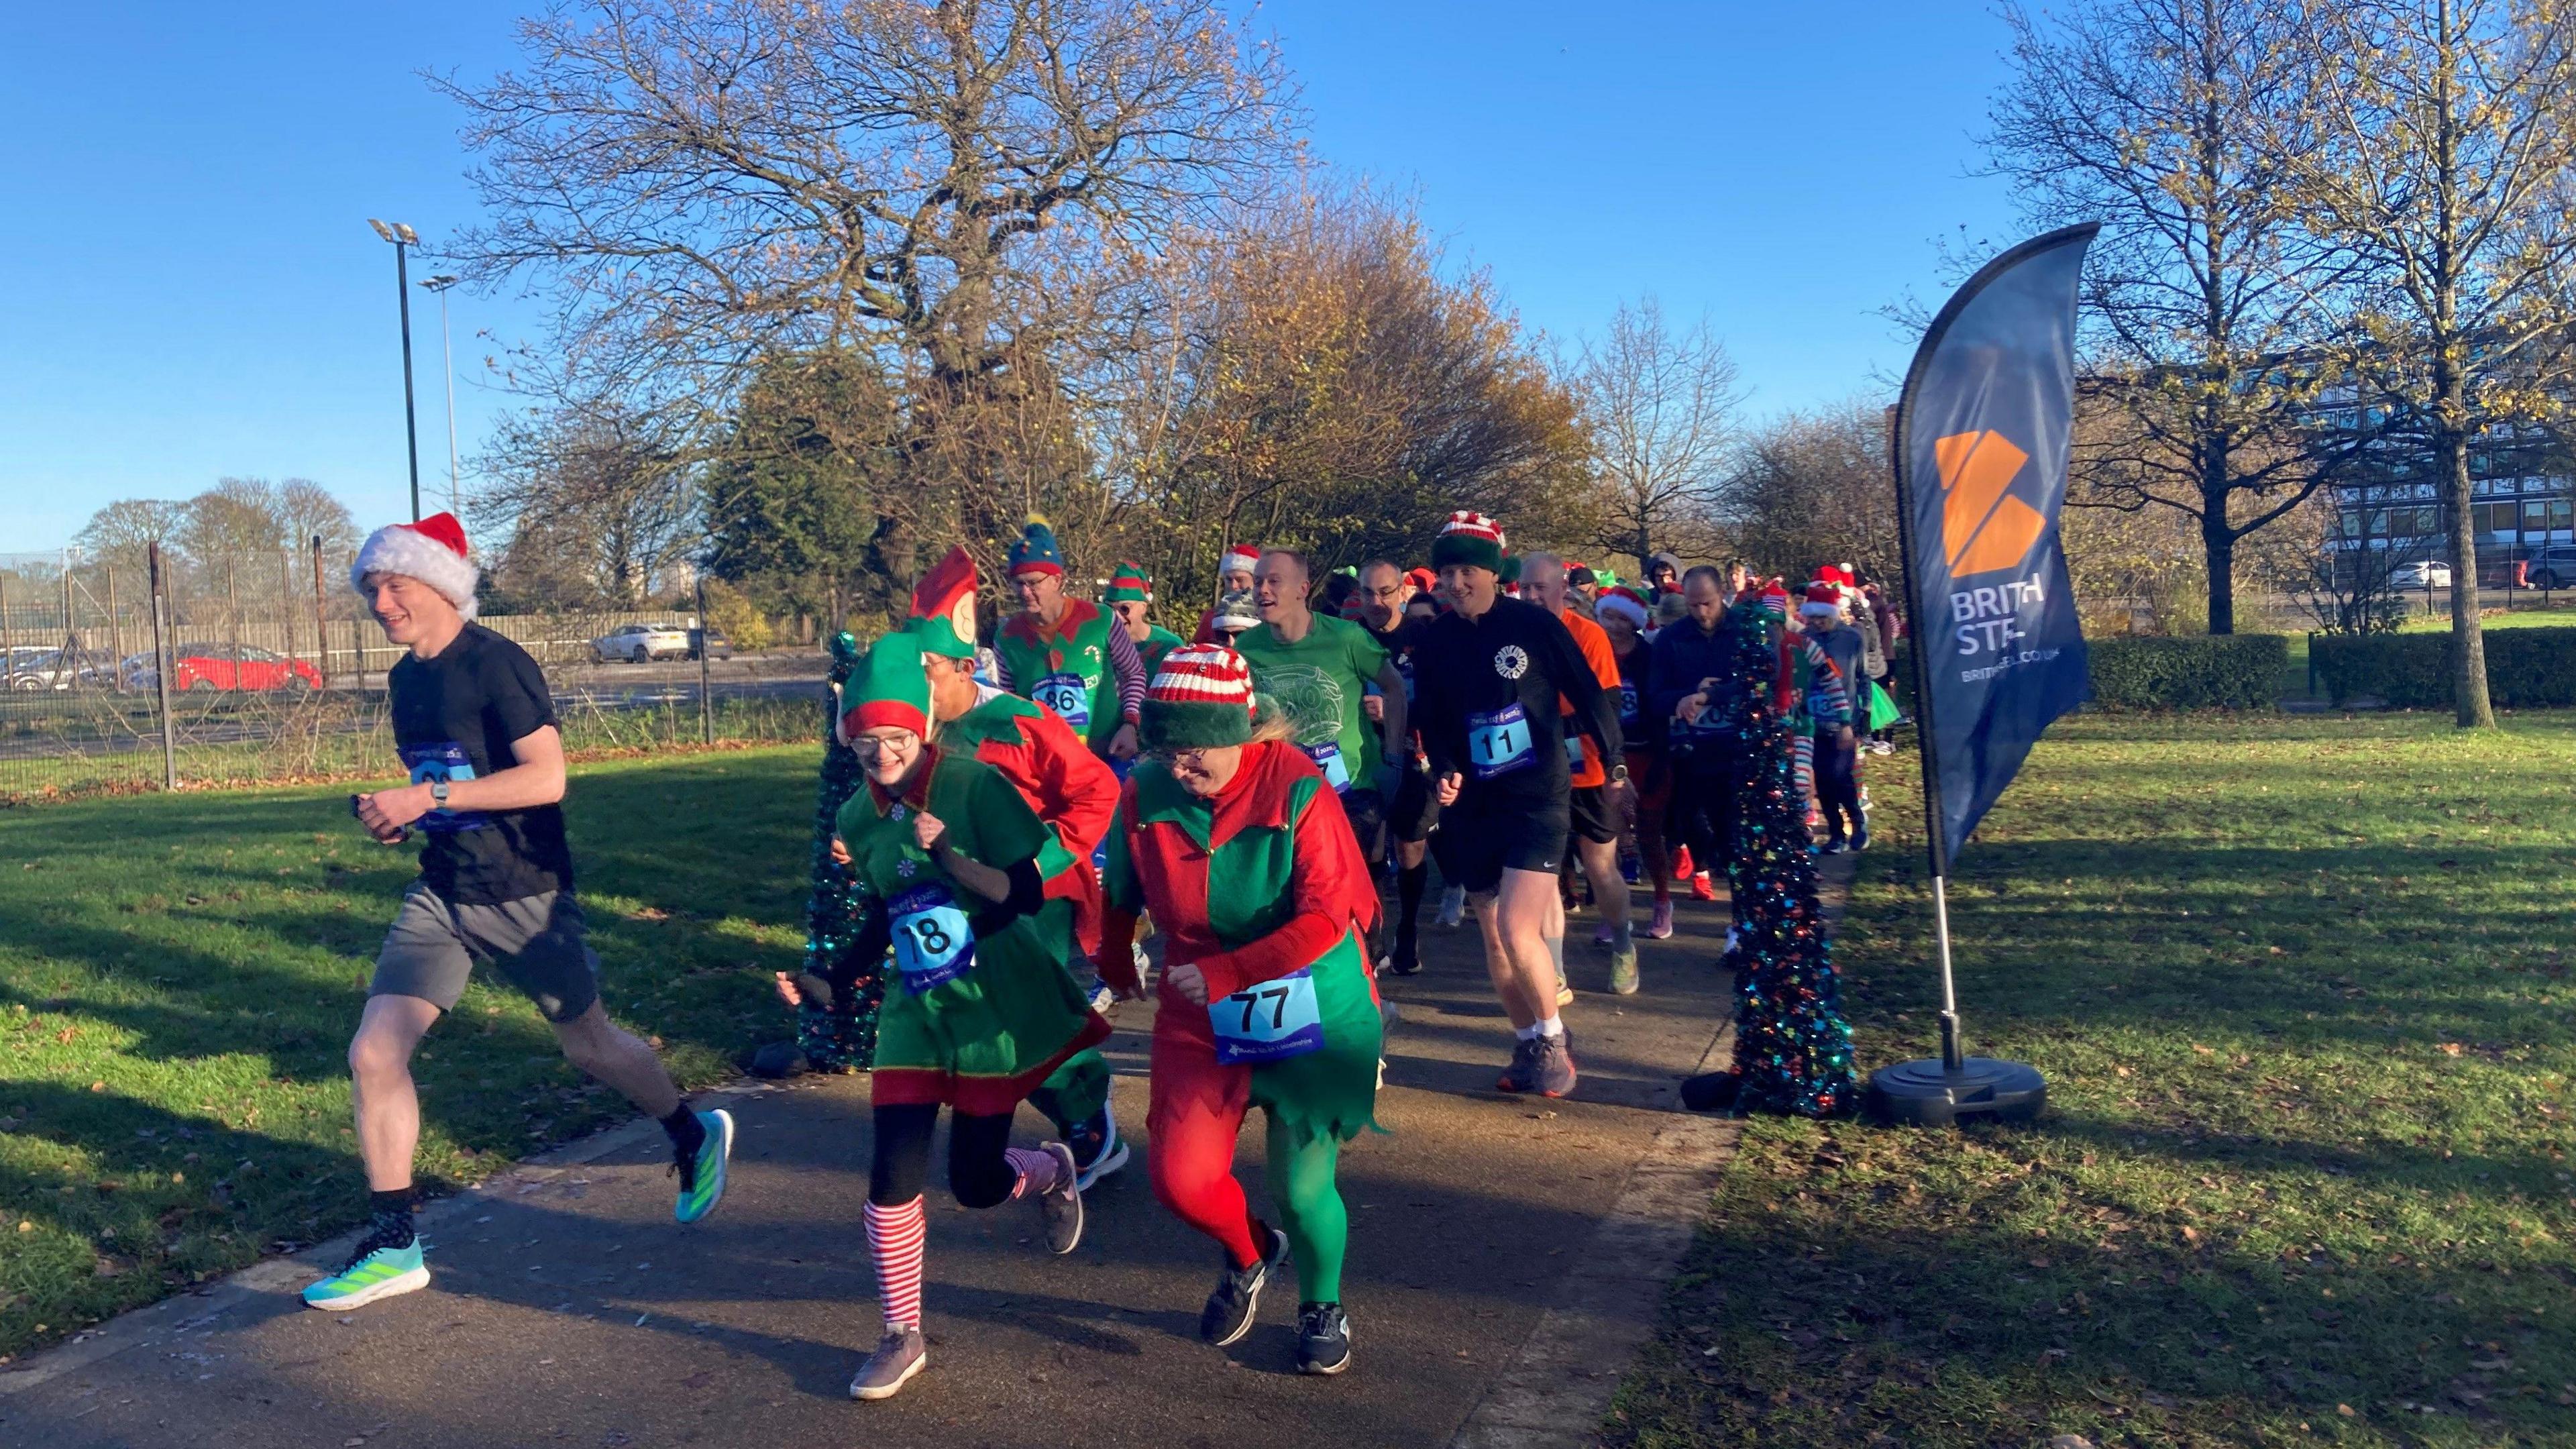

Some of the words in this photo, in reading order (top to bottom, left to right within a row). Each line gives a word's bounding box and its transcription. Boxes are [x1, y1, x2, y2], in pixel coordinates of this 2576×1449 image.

[1046, 690, 1075, 711] 86
[1481, 729, 1513, 759] 11
[899, 918, 951, 963] 18
[1230, 986, 1289, 1032] 77
